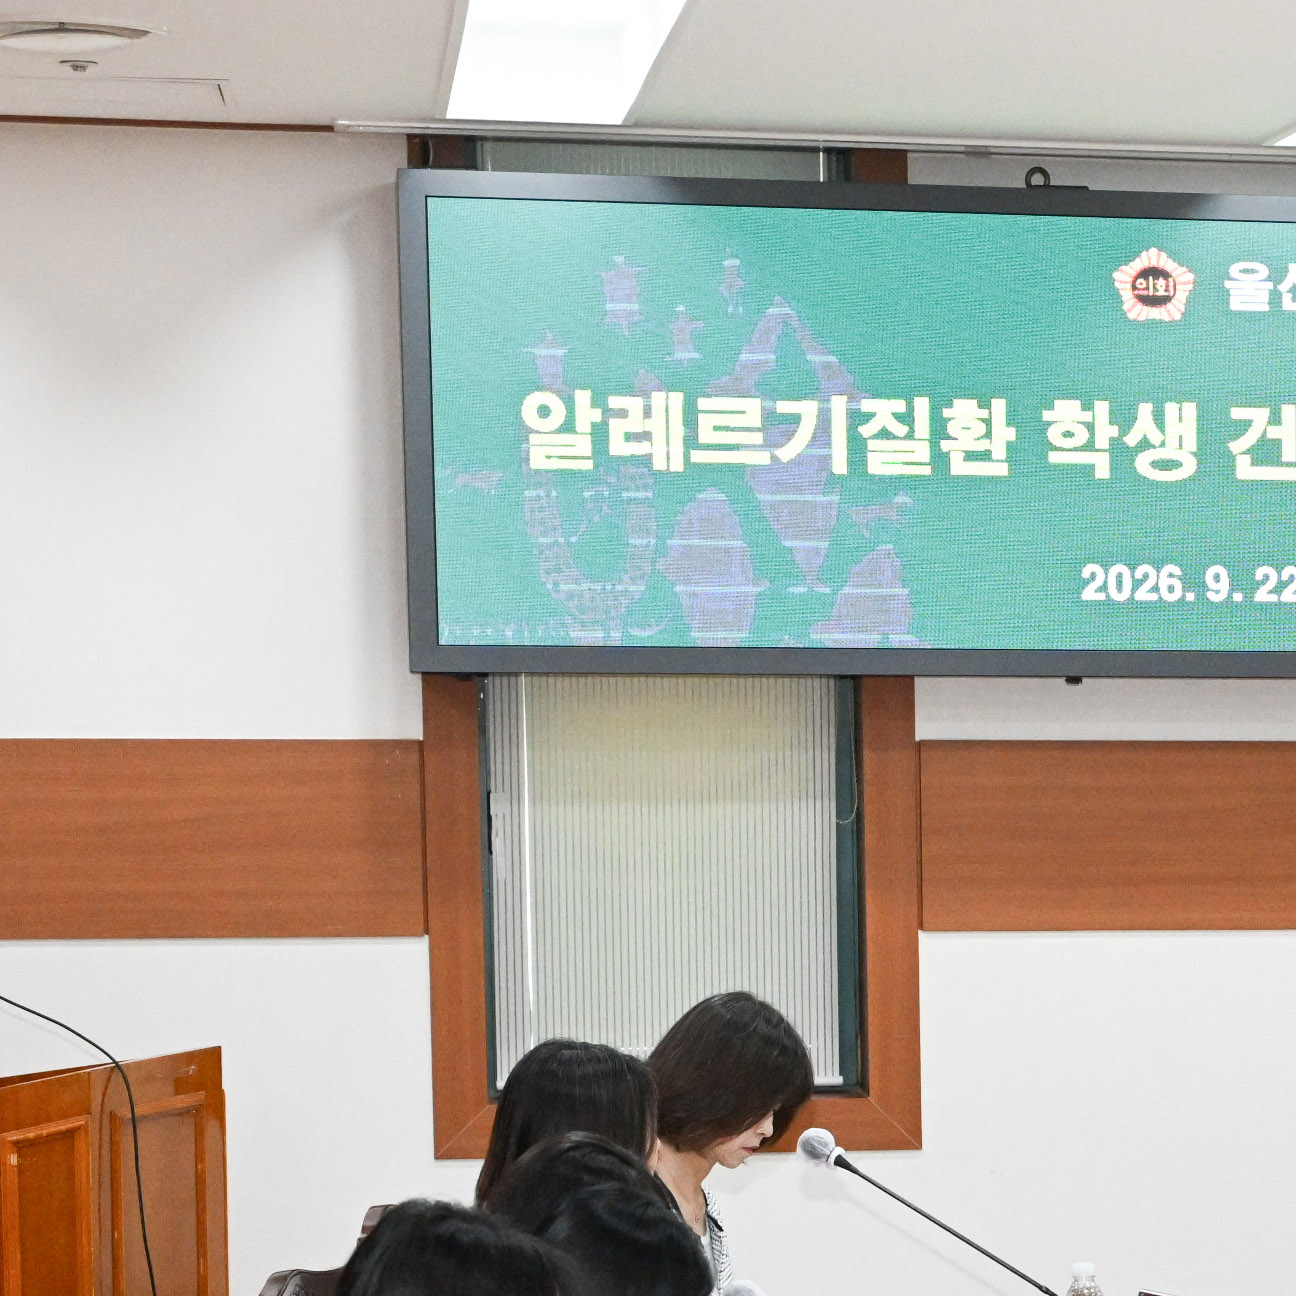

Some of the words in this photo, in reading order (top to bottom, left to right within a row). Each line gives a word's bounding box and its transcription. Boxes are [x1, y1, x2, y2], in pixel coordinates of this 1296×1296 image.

[1133, 275, 1176, 297] 의회
[520, 388, 1017, 477] 알레르기질환
[1041, 398, 1199, 483] 학생
